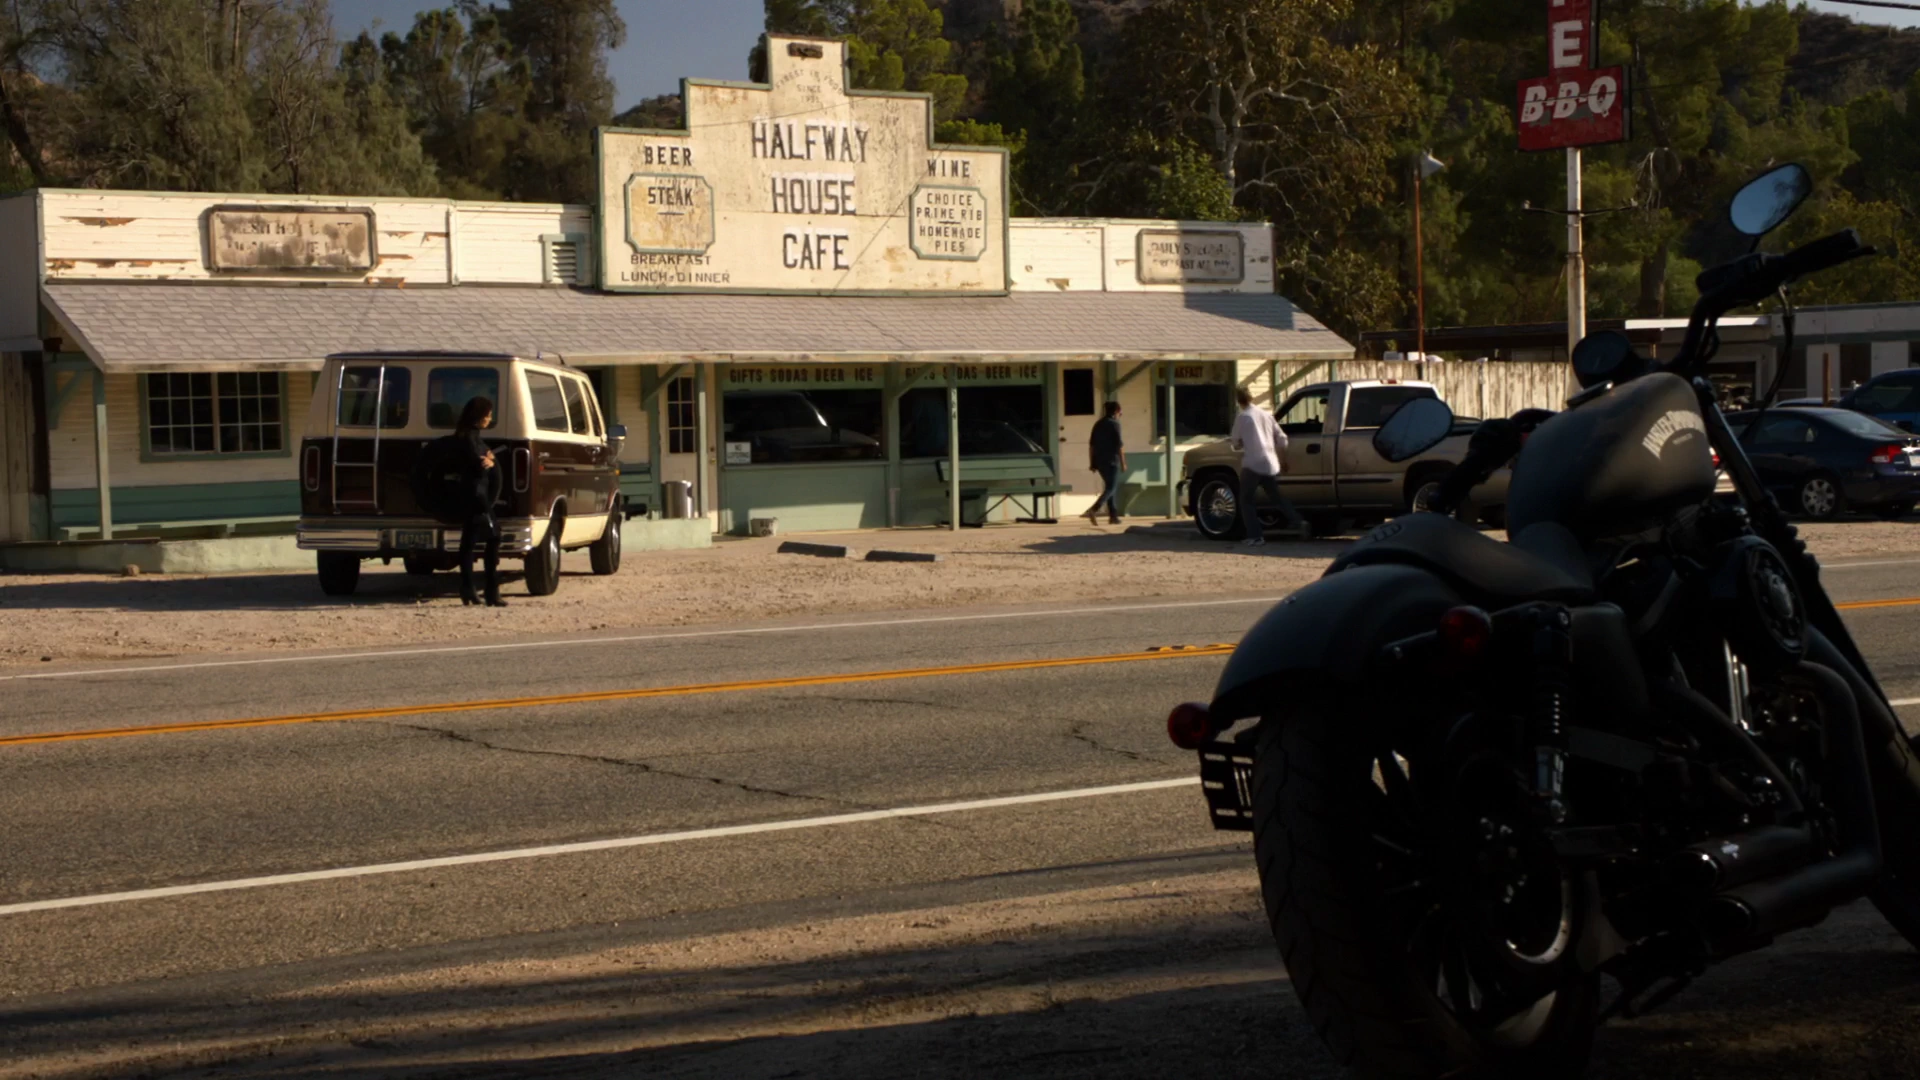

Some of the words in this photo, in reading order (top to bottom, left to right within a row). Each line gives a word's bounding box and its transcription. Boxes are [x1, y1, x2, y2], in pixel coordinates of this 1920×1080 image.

[752, 122, 869, 162] HALFWAY
[644, 146, 692, 166] BEER
[927, 159, 970, 178] WINE
[648, 187, 693, 206] STEAK
[771, 177, 856, 215] HOUSE
[927, 193, 973, 206] CHOICE
[916, 207, 954, 219] PRIME
[961, 209, 982, 221] RIB
[920, 226, 981, 239] HOMEMADE
[783, 233, 849, 270] CAFE
[935, 240, 966, 252] PIES
[631, 253, 711, 266] BREAKFAST
[621, 271, 667, 283] LUNCH
[677, 272, 730, 283] DINNER
[730, 369, 762, 383] GIFTS
[770, 368, 808, 382] SODAS
[815, 367, 845, 382] BEER
[854, 368, 874, 381] ICE
[942, 366, 978, 380] SDAS
[985, 366, 1012, 380] BEER
[1019, 365, 1038, 379] ICE
